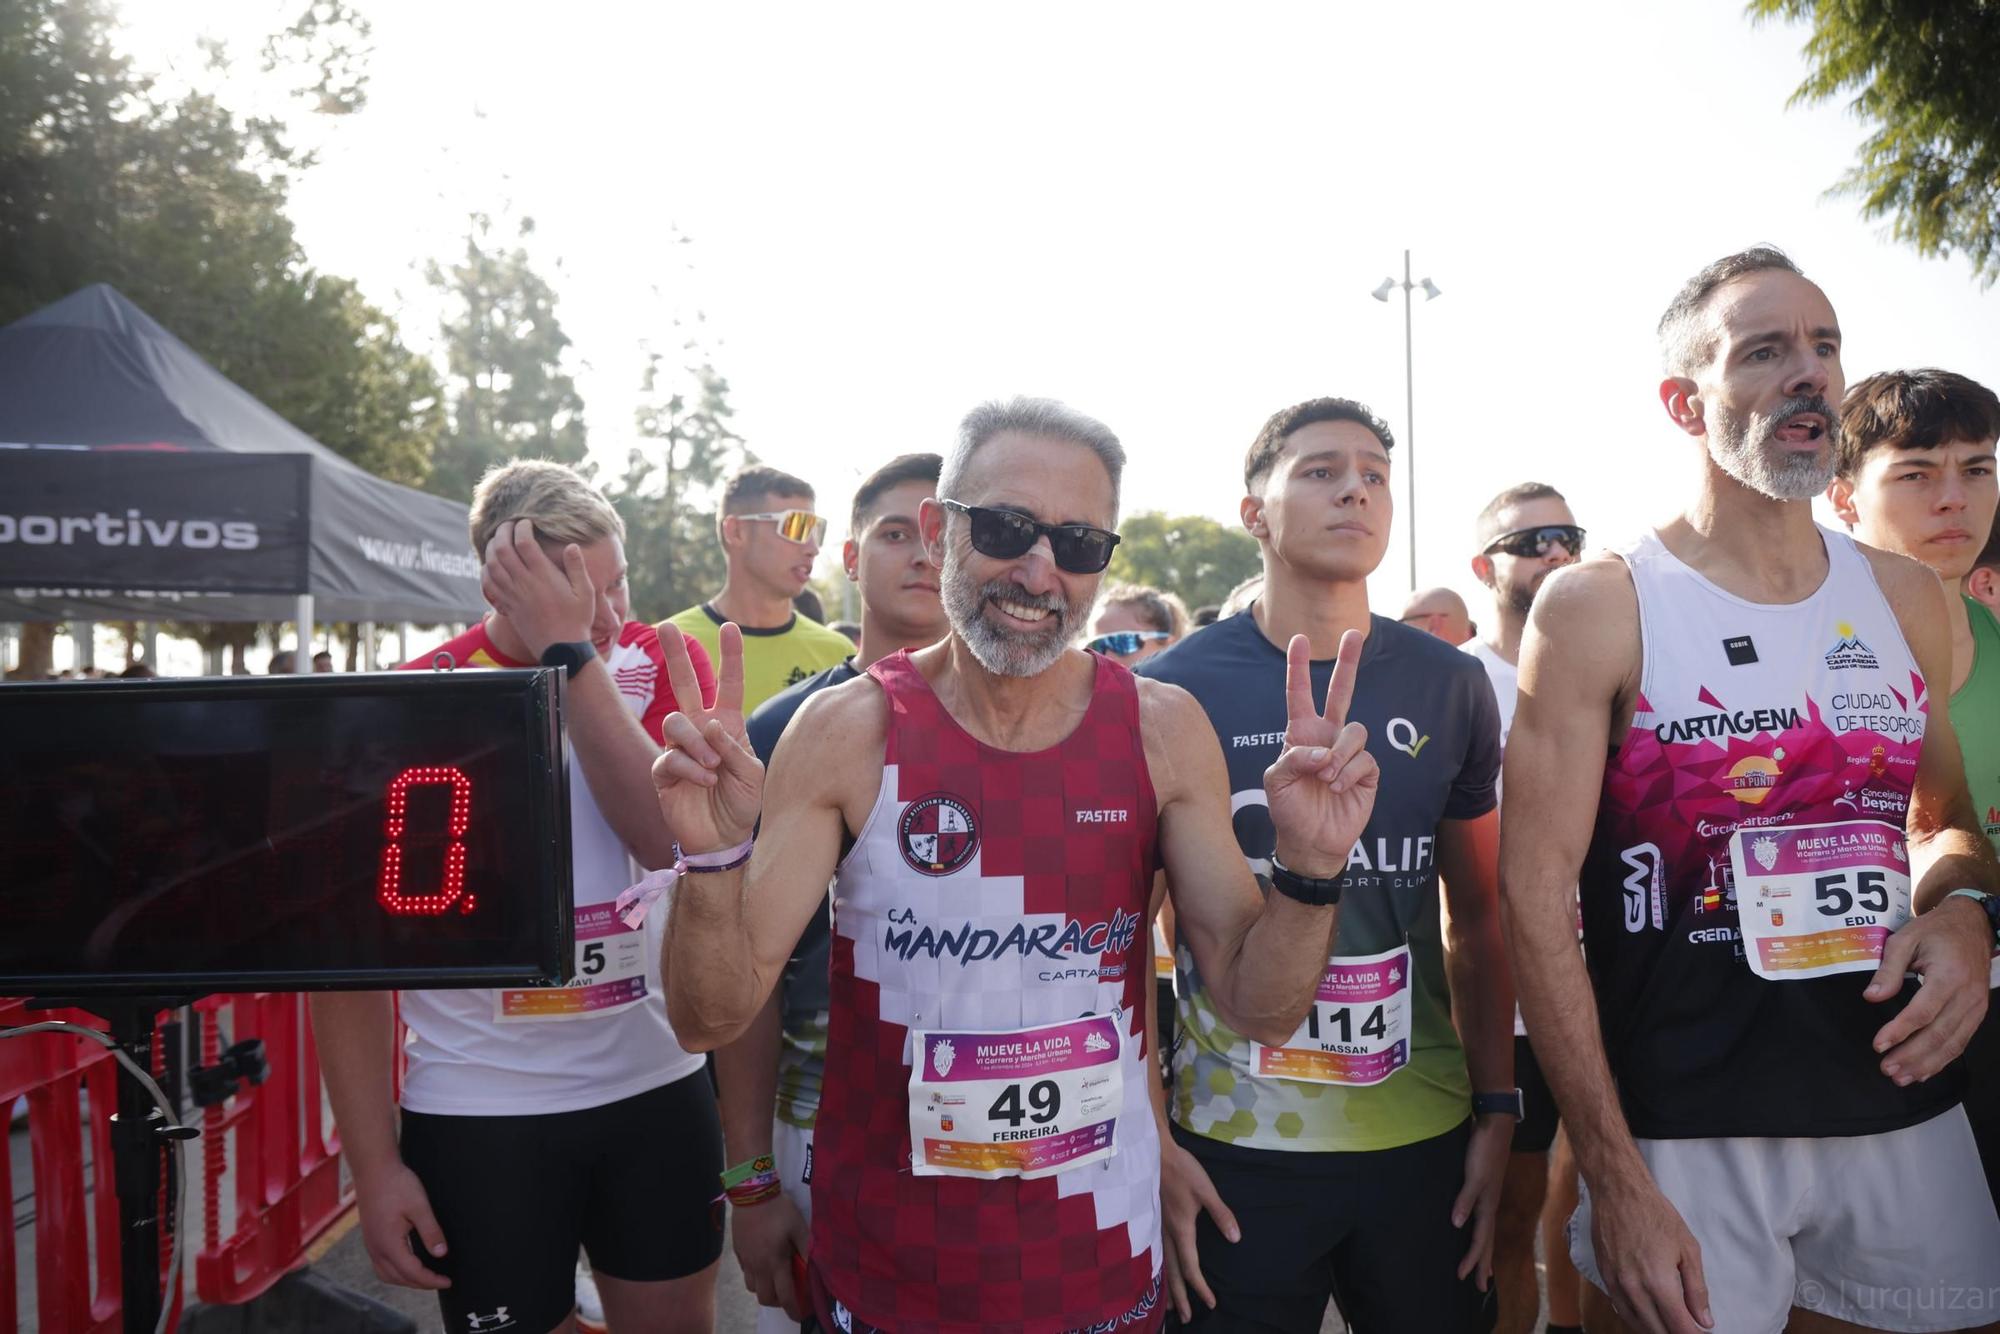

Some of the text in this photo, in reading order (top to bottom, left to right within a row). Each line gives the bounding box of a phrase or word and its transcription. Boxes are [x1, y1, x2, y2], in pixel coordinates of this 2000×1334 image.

[1831, 693, 1891, 710] CIUDAD
[1654, 707, 1803, 745] CARTAGENA
[1232, 732, 1285, 748] FASTER
[1076, 809, 1128, 823] FASTER
[1797, 833, 1887, 850] MUEVE LA VIDA
[1341, 874, 1432, 888] ORT CLIN
[1814, 871, 1889, 917] 55
[888, 908, 917, 924] C.A.
[1845, 915, 1876, 927] EDU
[885, 907, 1140, 968] MANDARACHE
[582, 942, 606, 975] 5
[568, 978, 593, 988] JAVI
[1340, 974, 1354, 983] LA
[1356, 972, 1380, 983] VIDA
[1308, 1004, 1387, 1043] 114
[977, 1036, 1071, 1057] MUEVE LA VIDA
[1321, 1042, 1368, 1055] HASSAN
[984, 1057, 1014, 1065] Carrera
[1020, 1053, 1046, 1062] Marcha
[1047, 1049, 1072, 1057] Urbana
[988, 1079, 1061, 1127] 49
[993, 1125, 1060, 1142] FERREIRA
